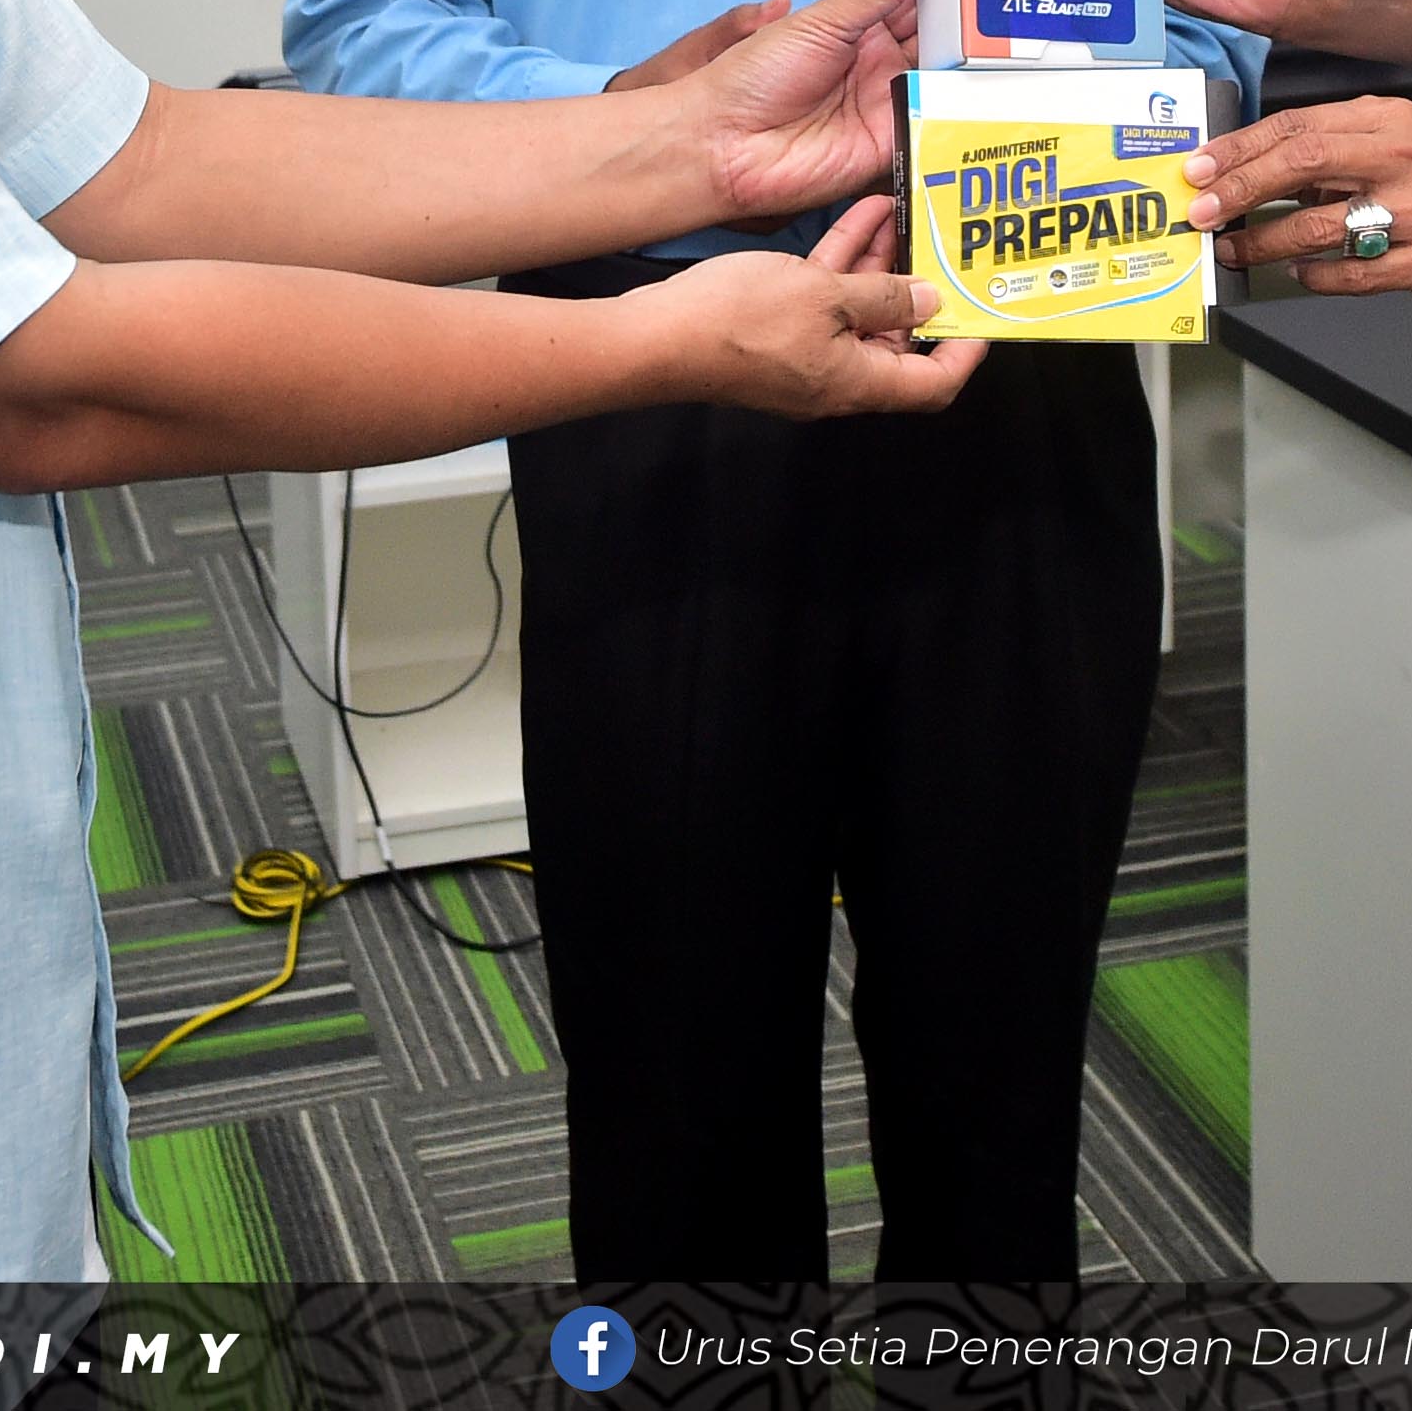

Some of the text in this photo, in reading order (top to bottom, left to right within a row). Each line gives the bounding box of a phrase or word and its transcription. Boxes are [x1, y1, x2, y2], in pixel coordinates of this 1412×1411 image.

[1083, 3, 1110, 16] L210
[962, 137, 1060, 164] #JOMINTERNET
[960, 154, 1058, 218] DIGI
[960, 191, 1168, 271] PREPAID
